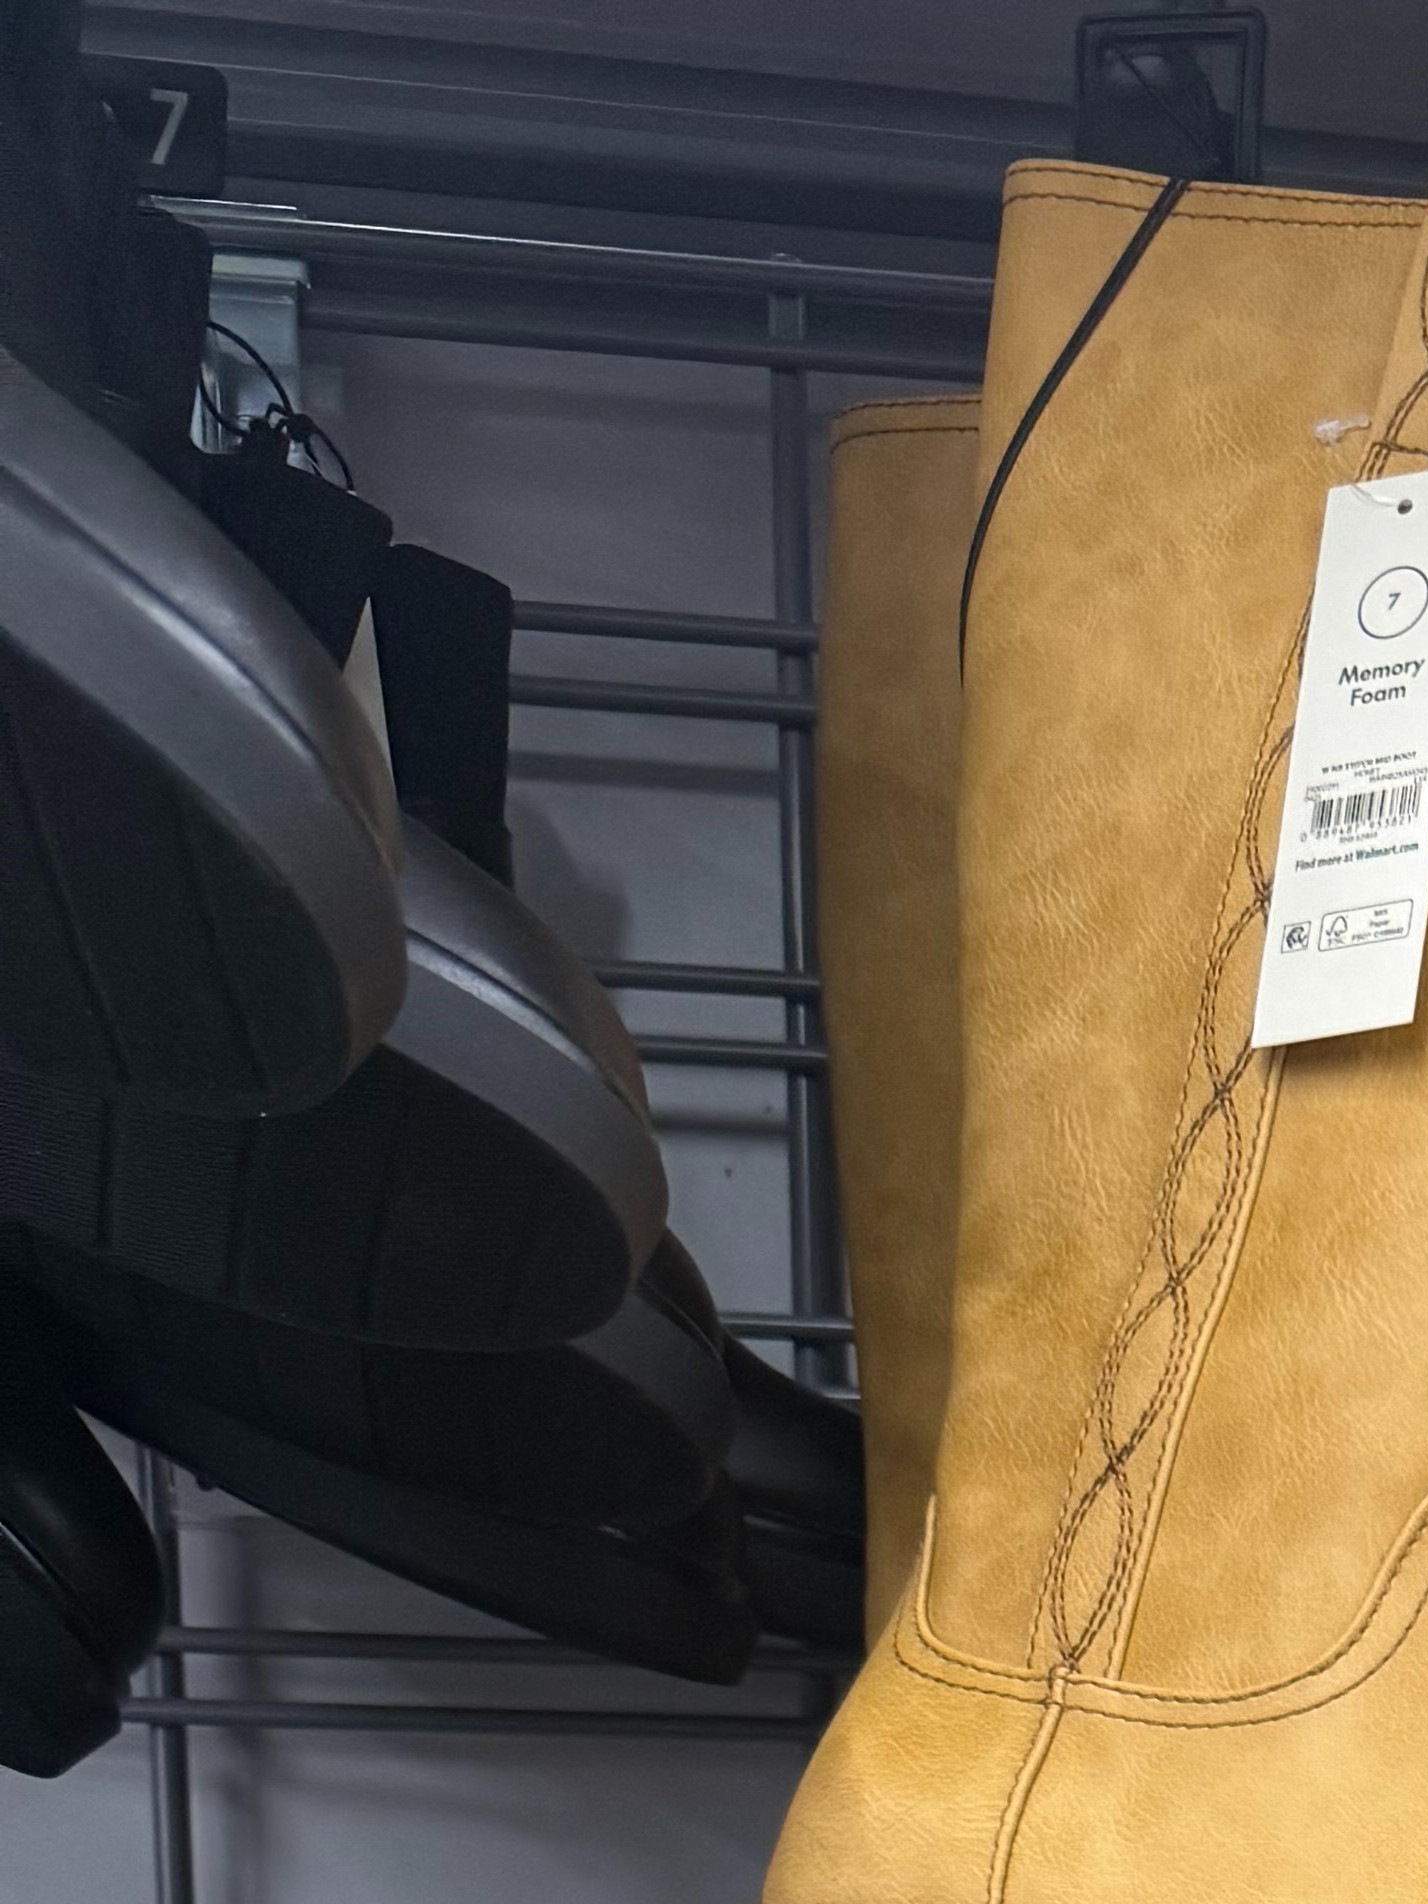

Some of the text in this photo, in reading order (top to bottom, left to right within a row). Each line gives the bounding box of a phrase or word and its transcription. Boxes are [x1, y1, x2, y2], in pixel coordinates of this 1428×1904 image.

[149, 87, 188, 165] 7
[1388, 592, 1401, 611] 7
[1337, 657, 1426, 687] Memory
[1350, 683, 1407, 707] Foam
[1356, 842, 1419, 861] Walmart.com
